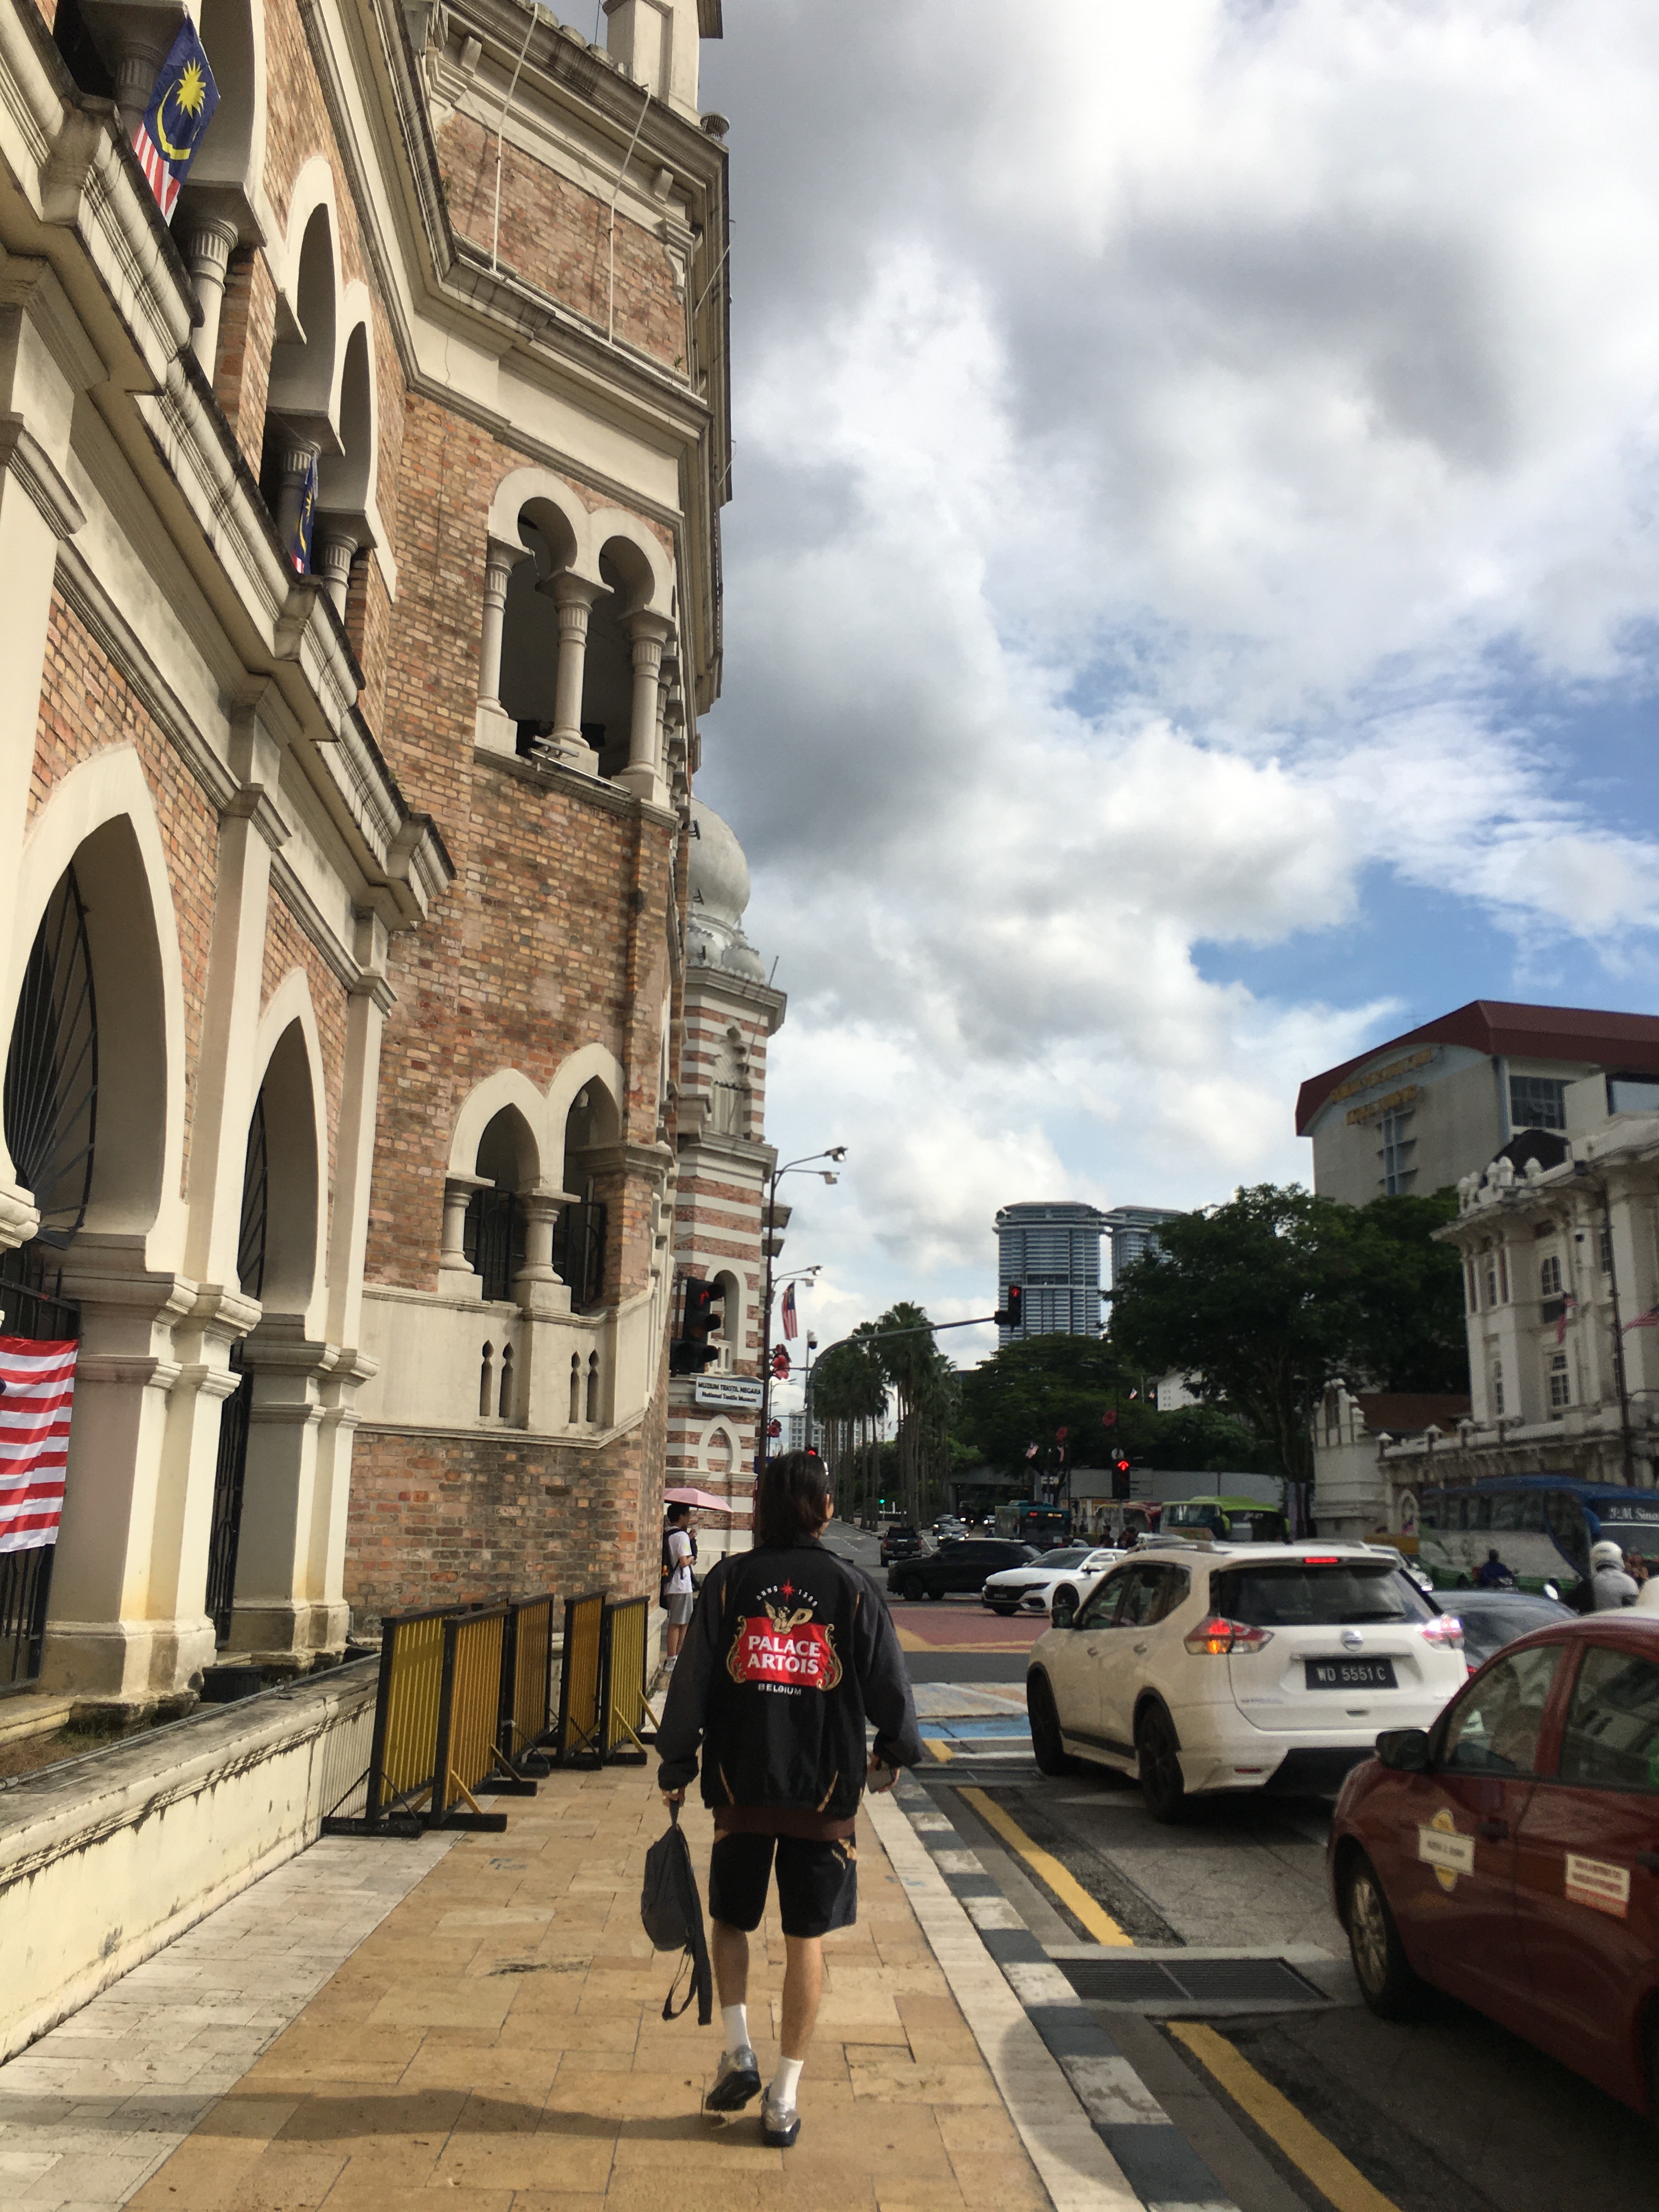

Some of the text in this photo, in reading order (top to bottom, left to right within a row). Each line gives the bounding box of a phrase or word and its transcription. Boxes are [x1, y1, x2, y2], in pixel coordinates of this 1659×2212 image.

[720, 1384, 740, 1392] TEKSTIL
[748, 1635, 821, 1657] PALACE
[748, 1653, 819, 1674] ARTOIS
[1317, 1667, 1386, 1681] WD 5551 C
[758, 1683, 802, 1696] BELGIUM
